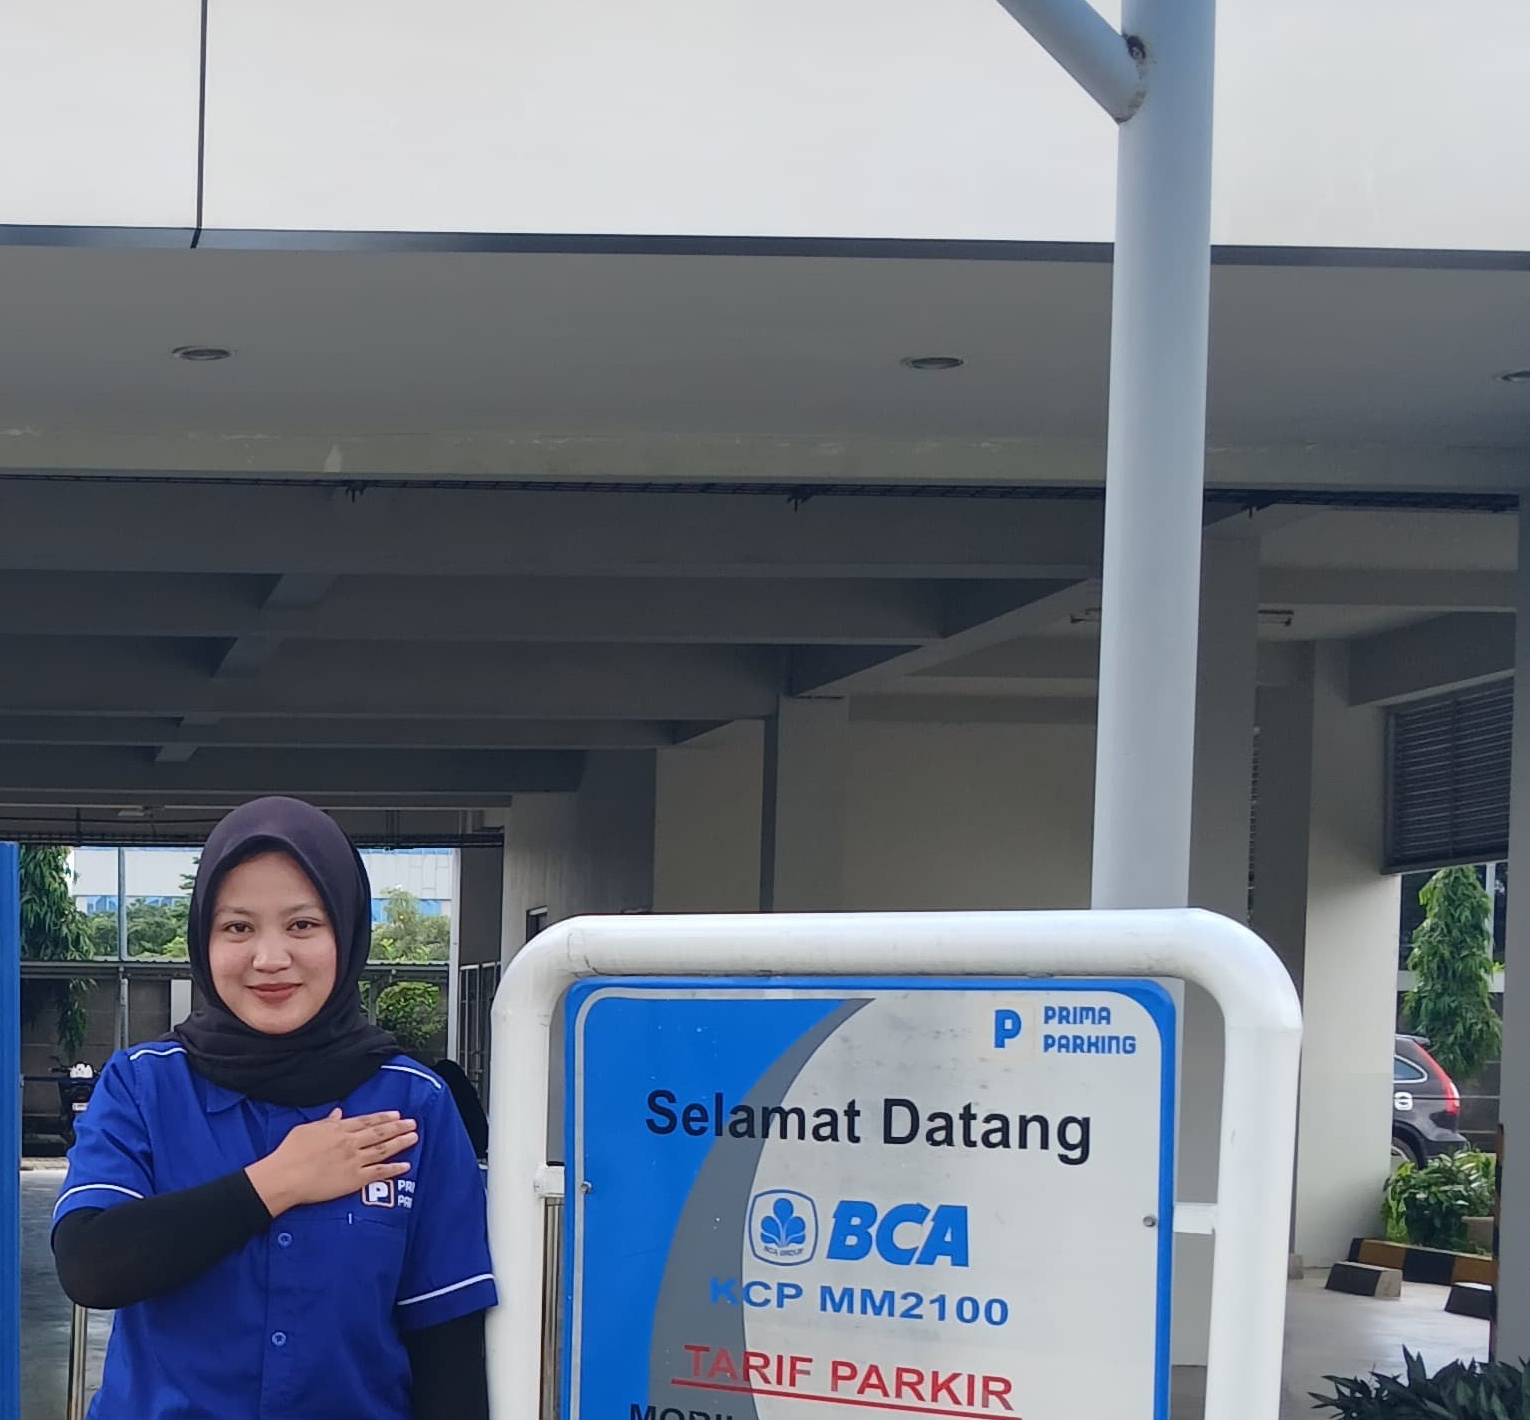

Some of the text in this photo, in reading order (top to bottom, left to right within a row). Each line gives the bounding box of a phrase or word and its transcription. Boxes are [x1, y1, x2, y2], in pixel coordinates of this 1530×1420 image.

[995, 1009, 1022, 1048] P
[1043, 1006, 1111, 1025] PRIMA
[1043, 1035, 1136, 1054] PARKING
[646, 1090, 1090, 1165] Selamat Datang
[827, 1200, 968, 1268] BCA
[710, 1277, 1009, 1326] KCP MM2100
[684, 1345, 1014, 1411] TARIF PARKIR
